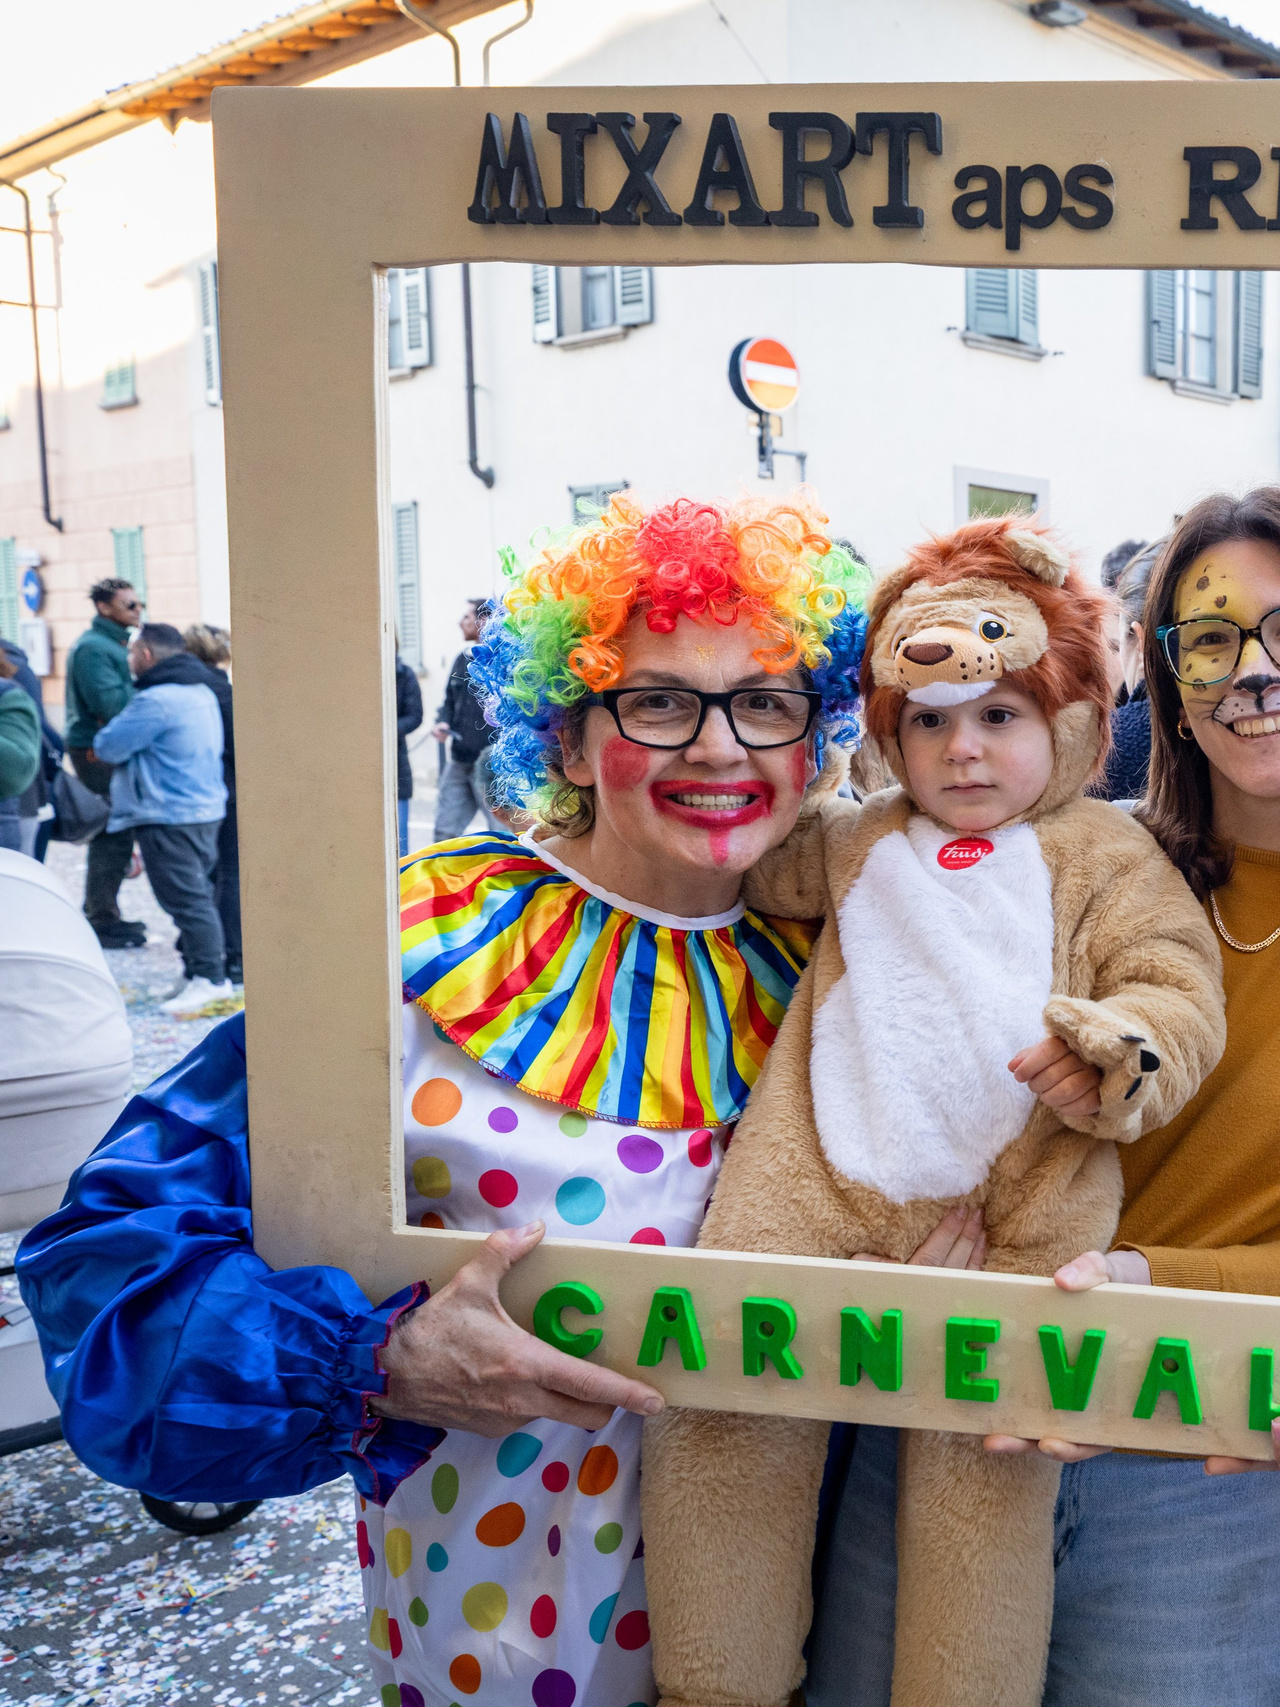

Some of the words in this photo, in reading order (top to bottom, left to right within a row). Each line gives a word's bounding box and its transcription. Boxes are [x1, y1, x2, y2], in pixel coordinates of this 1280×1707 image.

[467, 112, 942, 227] MIXART
[952, 163, 1114, 250] aps
[943, 845, 988, 859] Trudi
